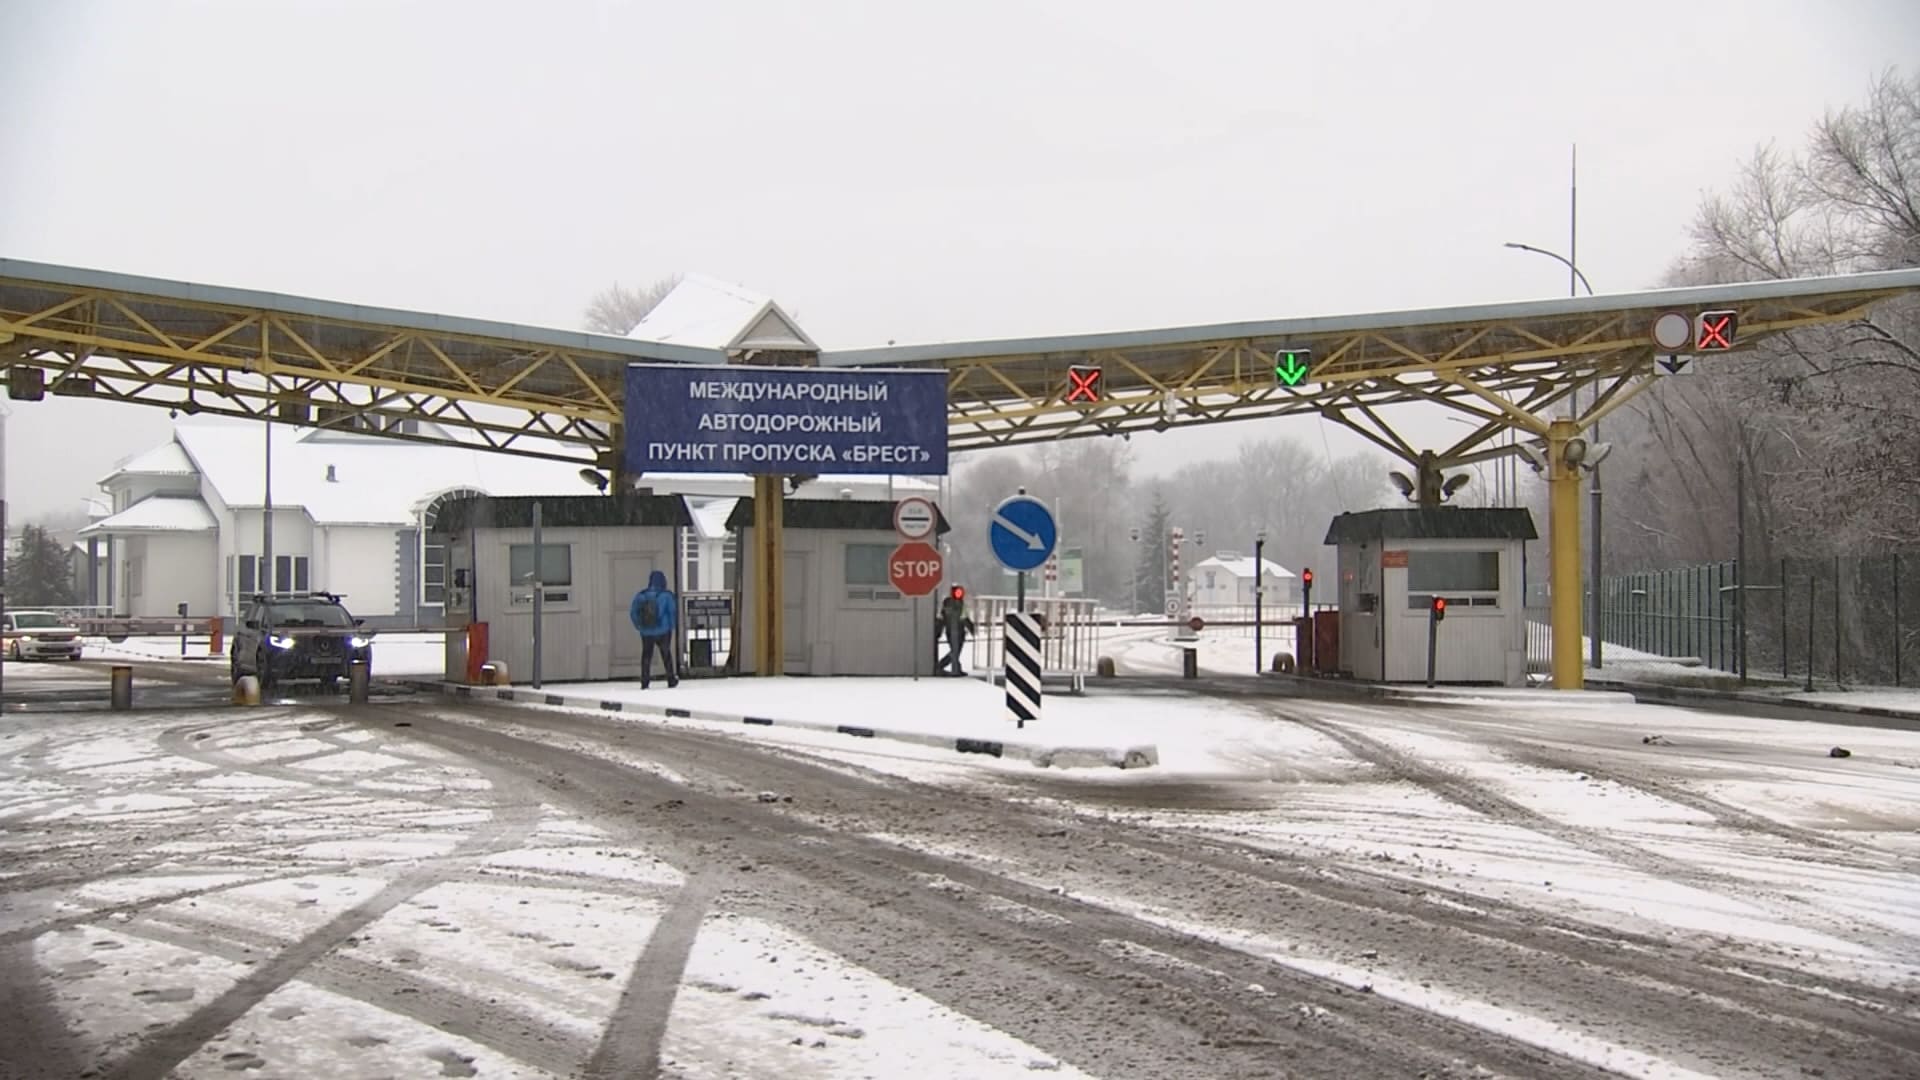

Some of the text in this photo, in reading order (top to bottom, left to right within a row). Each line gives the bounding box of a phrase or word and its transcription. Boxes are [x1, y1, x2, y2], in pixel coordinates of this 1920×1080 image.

[689, 380, 888, 403] МЕЖДУНАРОДНЫЙ
[698, 412, 882, 434] АВТОДОРОЖНЫЙ
[648, 442, 931, 463] ПУНКТ ПРОПУСКА «БРЕСТ»
[892, 560, 941, 578] STOP
